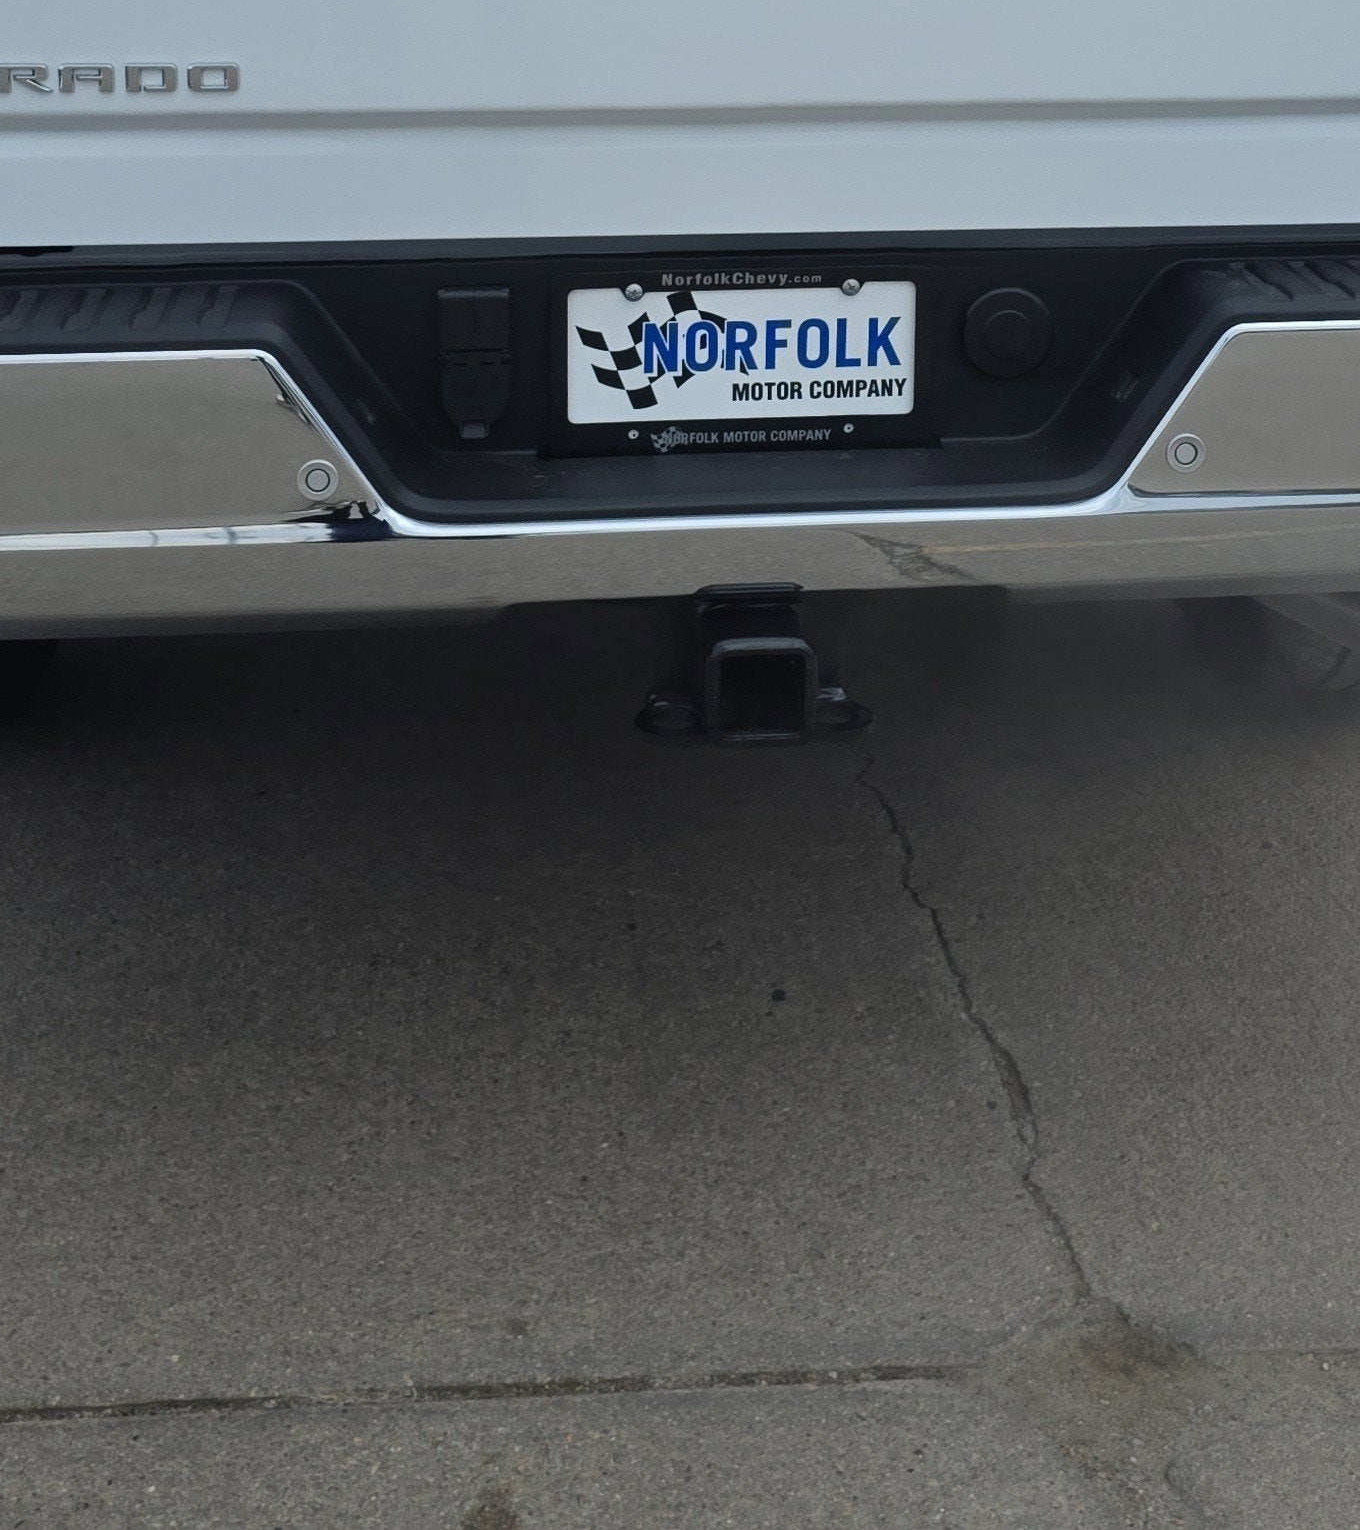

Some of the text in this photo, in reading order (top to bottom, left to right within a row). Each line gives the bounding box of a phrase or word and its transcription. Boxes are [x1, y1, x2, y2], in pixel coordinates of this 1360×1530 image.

[661, 272, 823, 287] NorfolkChevy.com
[642, 316, 903, 376] NORFOLK
[731, 377, 907, 402] MOTOR COMPANY
[722, 430, 767, 444] MOTOR
[770, 427, 833, 442] COMPANY
